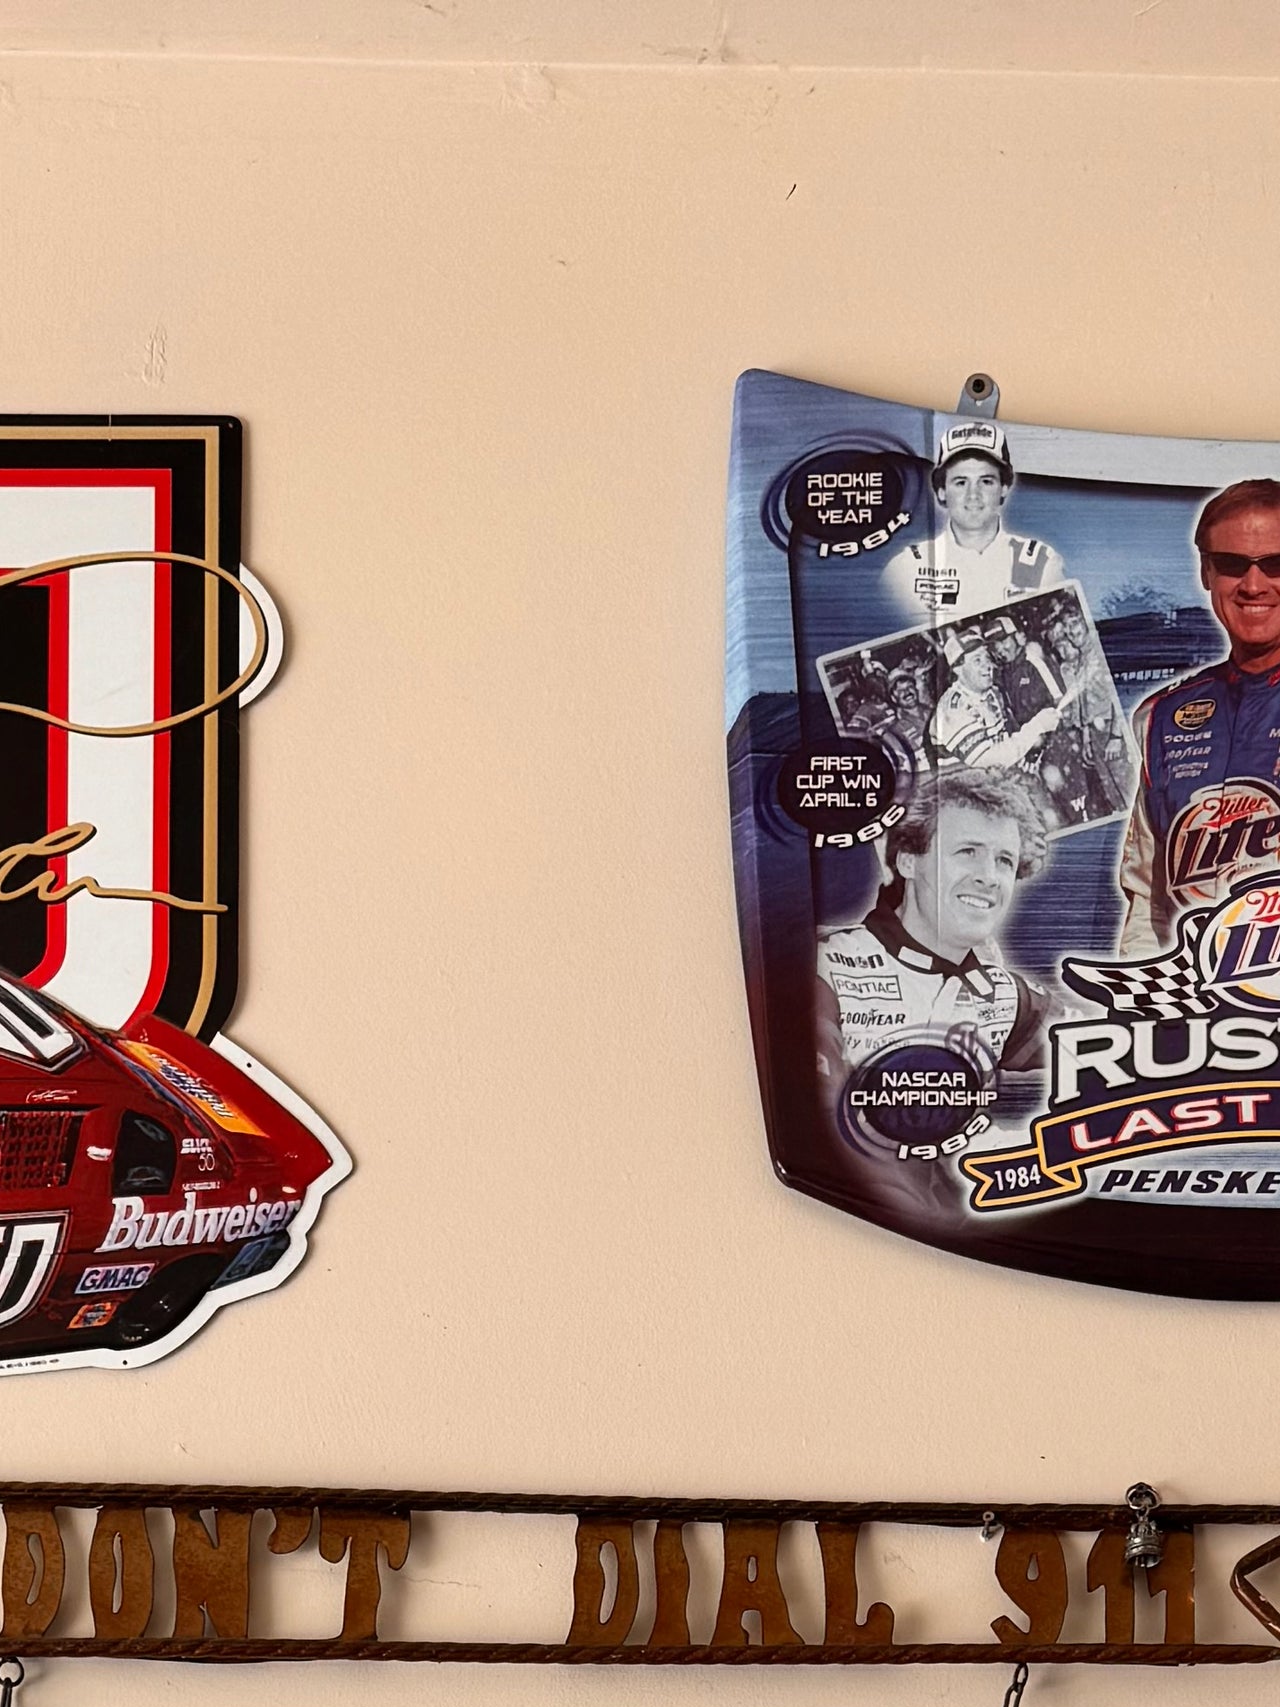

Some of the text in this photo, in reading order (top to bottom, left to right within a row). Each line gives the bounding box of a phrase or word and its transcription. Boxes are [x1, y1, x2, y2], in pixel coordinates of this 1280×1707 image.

[807, 472, 883, 490] ROOKIE
[807, 490, 883, 506] OF THE
[817, 508, 873, 525] YEAR
[819, 510, 913, 557] 1984
[810, 755, 867, 773] FIRST
[796, 774, 882, 790] CUP WIN
[865, 791, 878, 807] 6
[1202, 794, 1270, 822] Miller
[815, 803, 907, 849] 1986
[836, 979, 900, 995] PONTIAC
[881, 1071, 966, 1087] NASCAR
[850, 1090, 998, 1107] CHAMPIONSHIP
[1070, 1092, 1271, 1152] LAST
[898, 1113, 992, 1161] 1989
[993, 1164, 1042, 1191] 1984
[94, 1191, 302, 1253] Budweiser
[79, 1265, 151, 1290] GMAC
[0, 1503, 413, 1642] DON'T
[565, 1515, 896, 1648] DIAL
[990, 1525, 1197, 1646] 911
